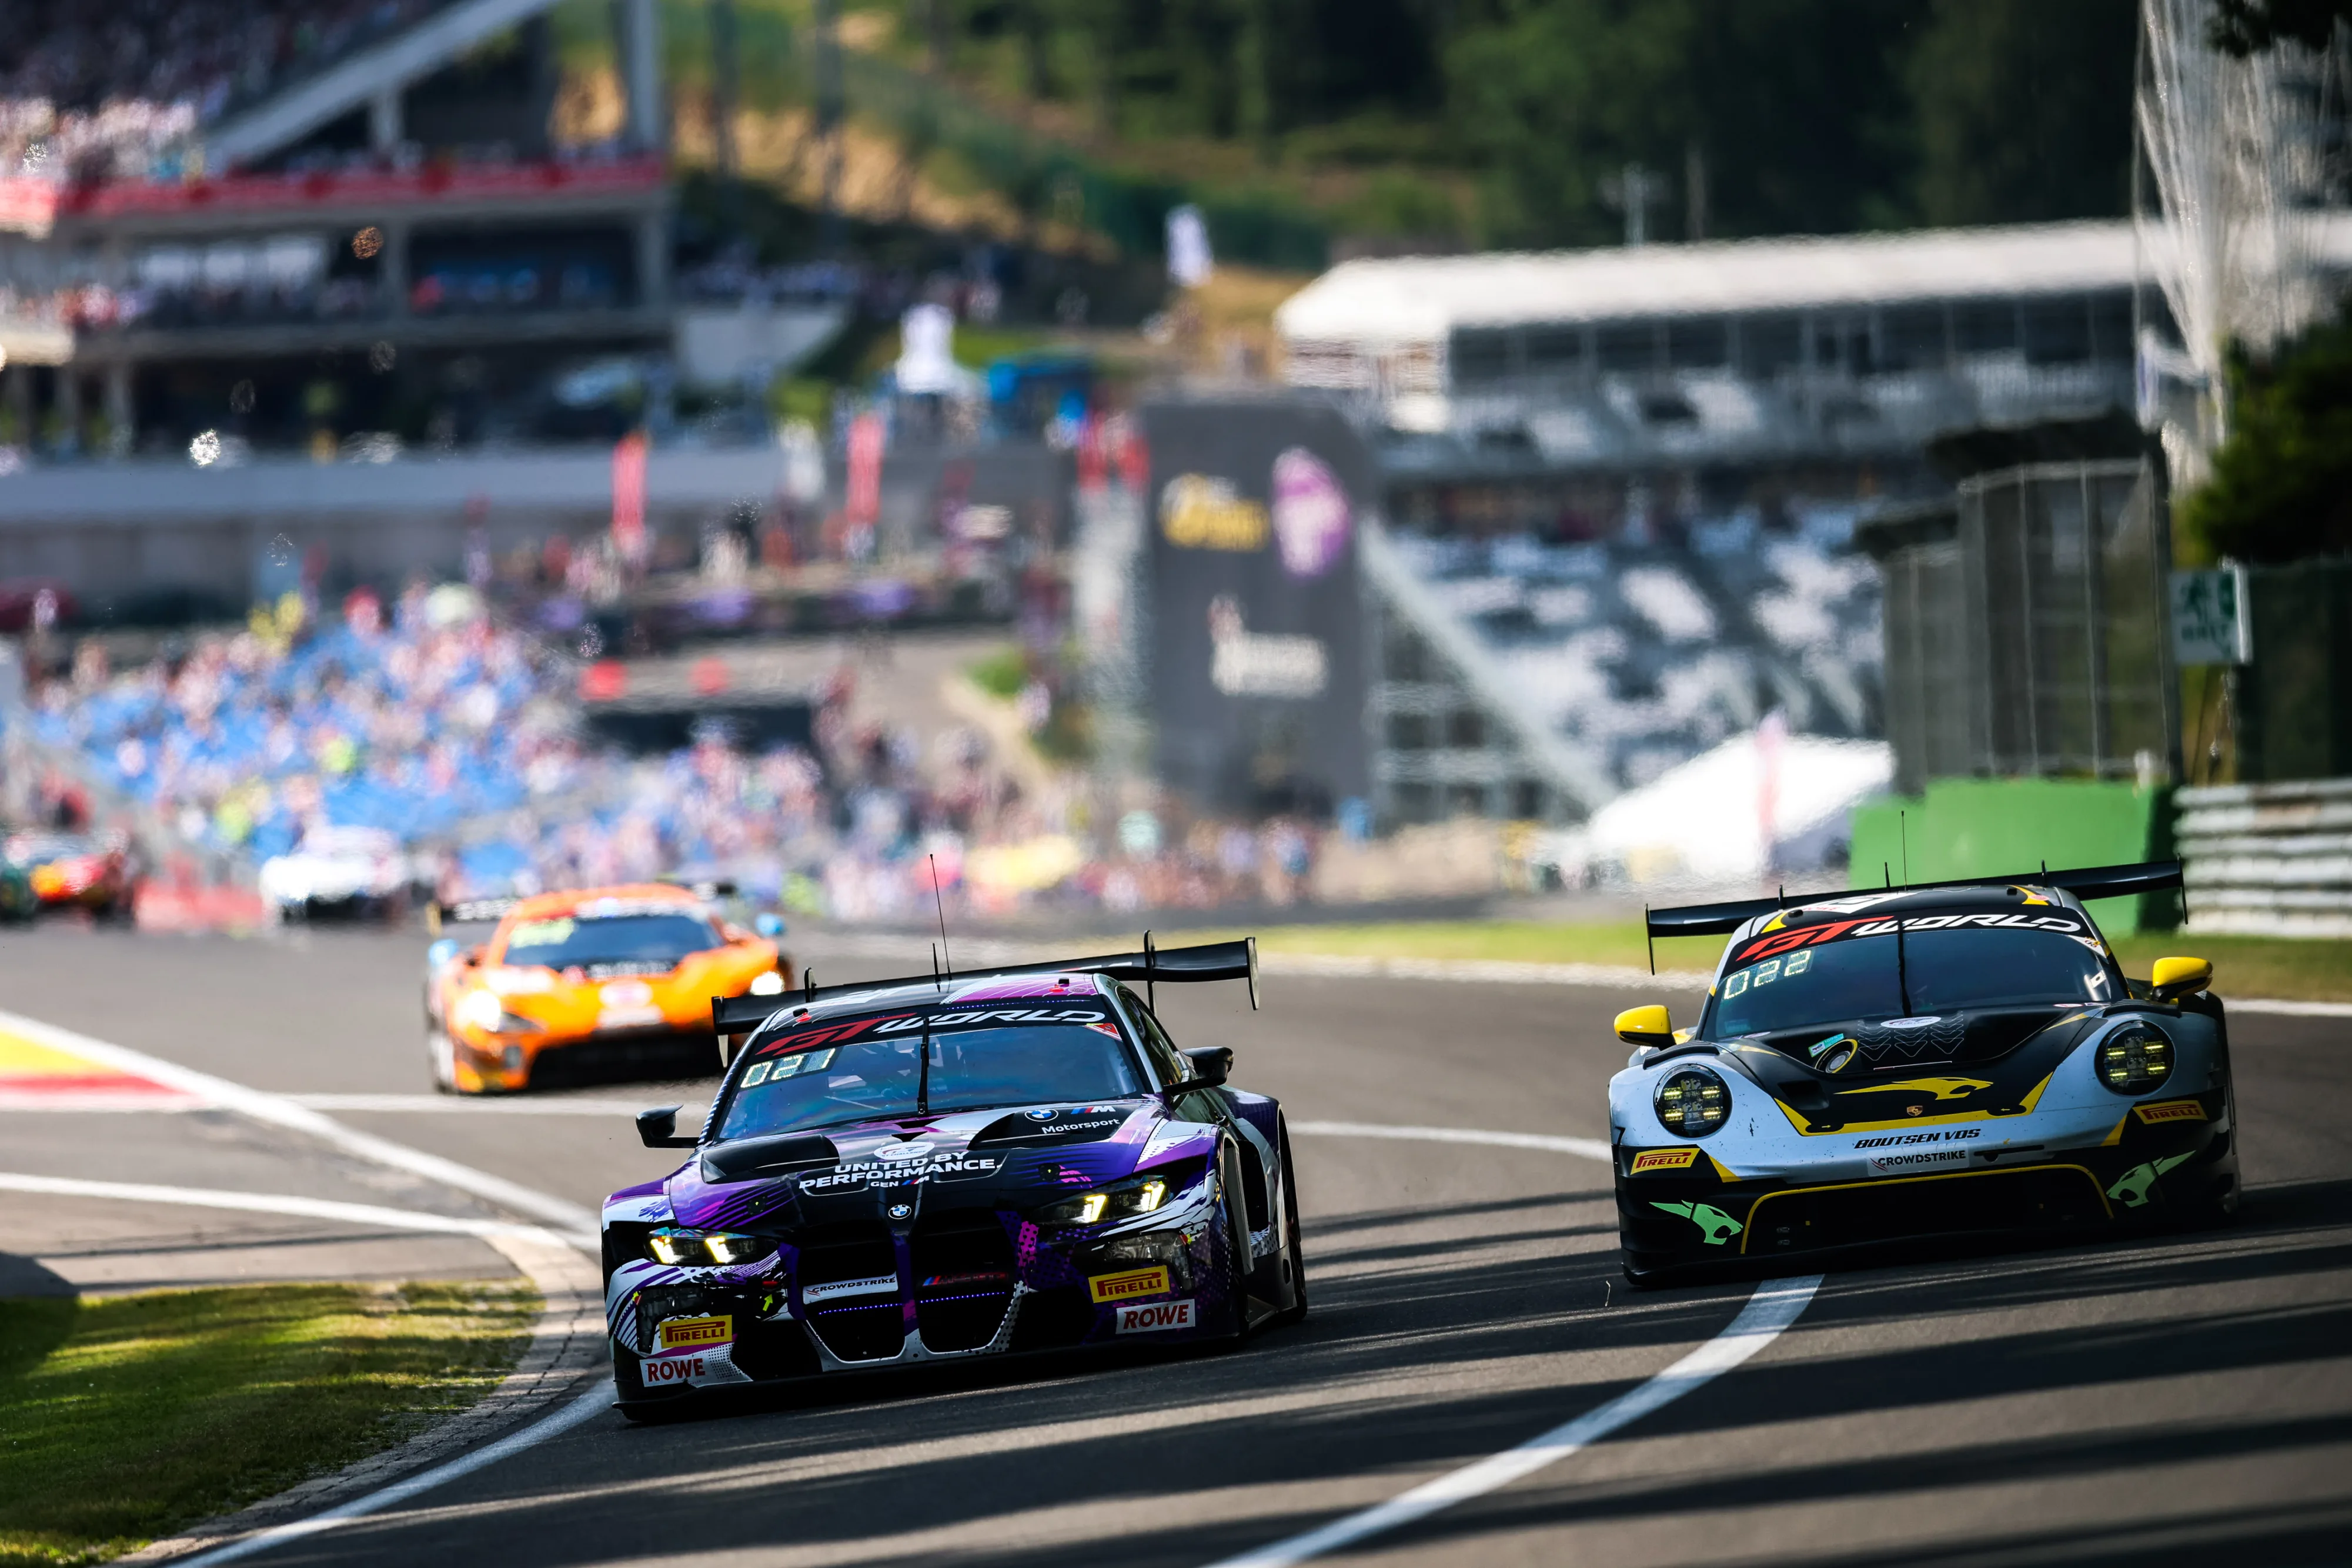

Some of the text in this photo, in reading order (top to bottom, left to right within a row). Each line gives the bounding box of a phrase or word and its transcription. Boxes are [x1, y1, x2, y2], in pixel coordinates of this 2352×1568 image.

[1735, 914, 2081, 962] GT WORLD
[1723, 949, 1812, 1000] 022
[755, 1009, 1105, 1056] GT WORLD
[740, 1048, 836, 1088] 021
[2140, 1104, 2201, 1120] PIRELLI
[1041, 1118, 1121, 1134] Motorsport
[1854, 1132, 1942, 1149] BOUTSEN
[834, 1151, 971, 1174] UNITED BY
[1635, 1152, 1692, 1169] PIRELLI
[1877, 1150, 1966, 1166] CROWDSTRIKE
[812, 1276, 896, 1293] CROWDSTRIKE
[1096, 1272, 1162, 1297] PIRELLI
[1123, 1303, 1189, 1329] ROWE
[665, 1320, 726, 1343] PIRELLI
[646, 1358, 706, 1382] ROWE
